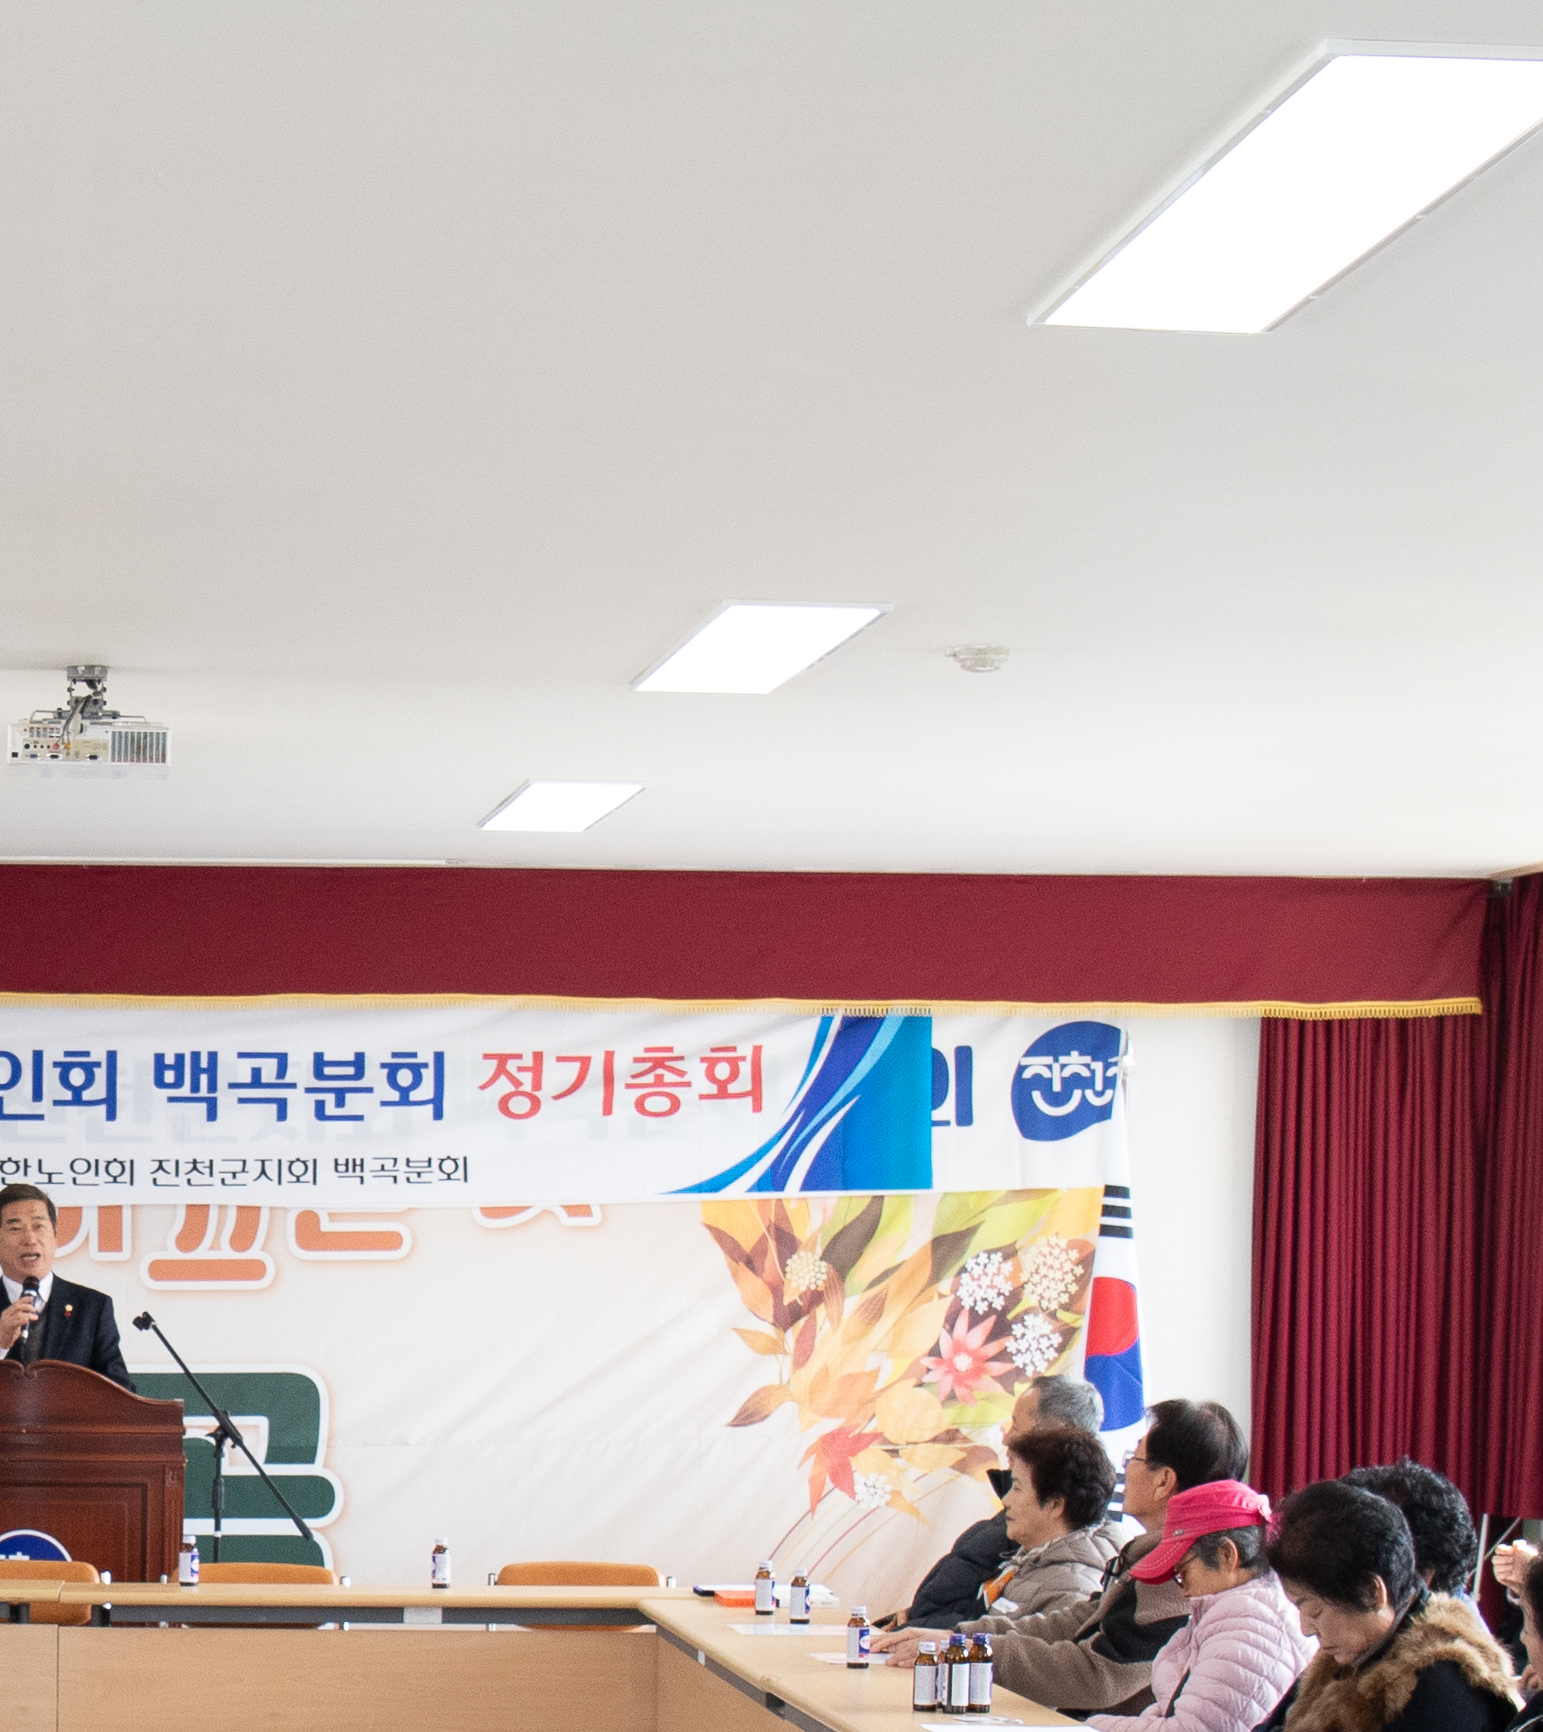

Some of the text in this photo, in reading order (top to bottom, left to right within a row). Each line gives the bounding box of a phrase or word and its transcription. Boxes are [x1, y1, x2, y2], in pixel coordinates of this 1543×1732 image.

[151, 1049, 446, 1123] 백곡분회
[478, 1044, 764, 1120] 정기총회
[148, 1155, 319, 1188] 진천군지회
[332, 1155, 470, 1188] 백곡분회
